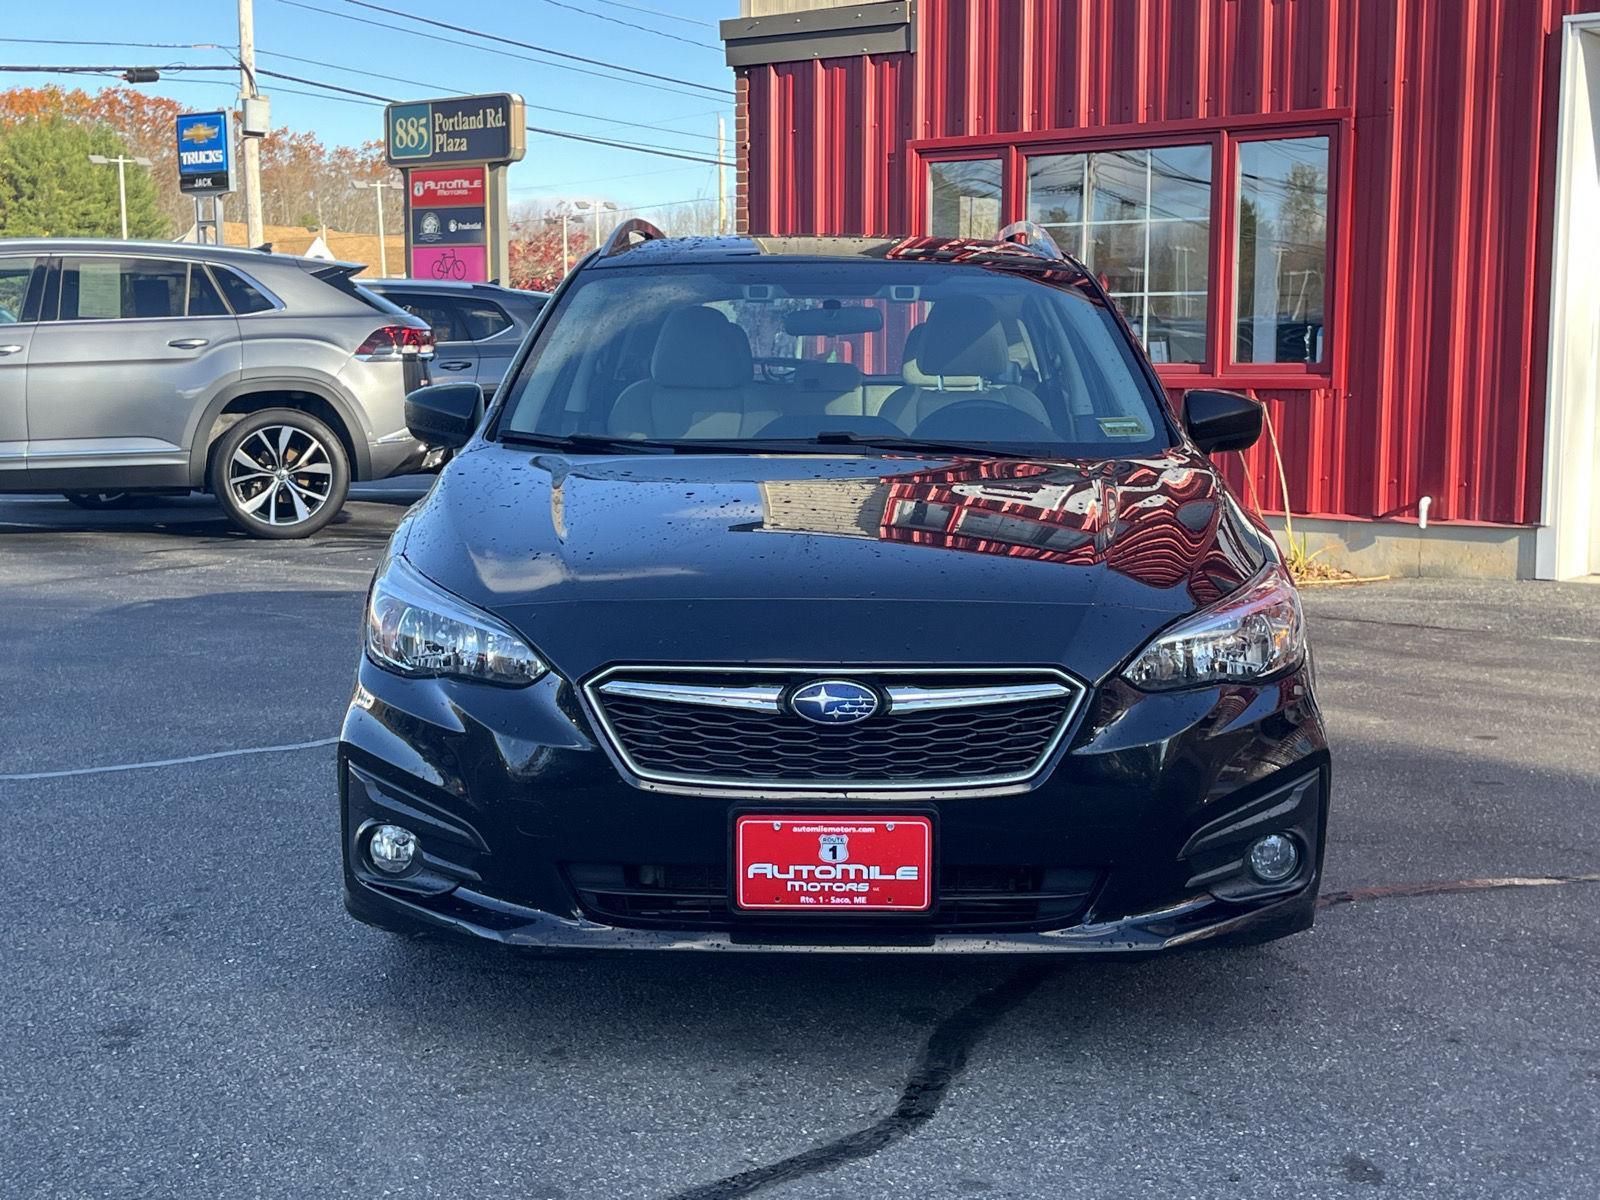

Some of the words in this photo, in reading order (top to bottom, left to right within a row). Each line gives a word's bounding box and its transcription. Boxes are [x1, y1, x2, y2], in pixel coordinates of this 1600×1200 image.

[434, 109, 484, 133] Portland
[486, 107, 506, 128] Rd.
[395, 117, 428, 150] 885
[434, 132, 468, 153] Plaza
[180, 149, 224, 166] TRUCKS
[194, 177, 213, 188] JACK
[792, 825, 876, 834] automilemotors.com
[829, 845, 838, 860] 1
[787, 881, 870, 892] MOTORS
[800, 896, 816, 904] Rte.
[818, 896, 823, 904] 1
[830, 896, 852, 904] Saco,
[853, 896, 867, 904] ME
